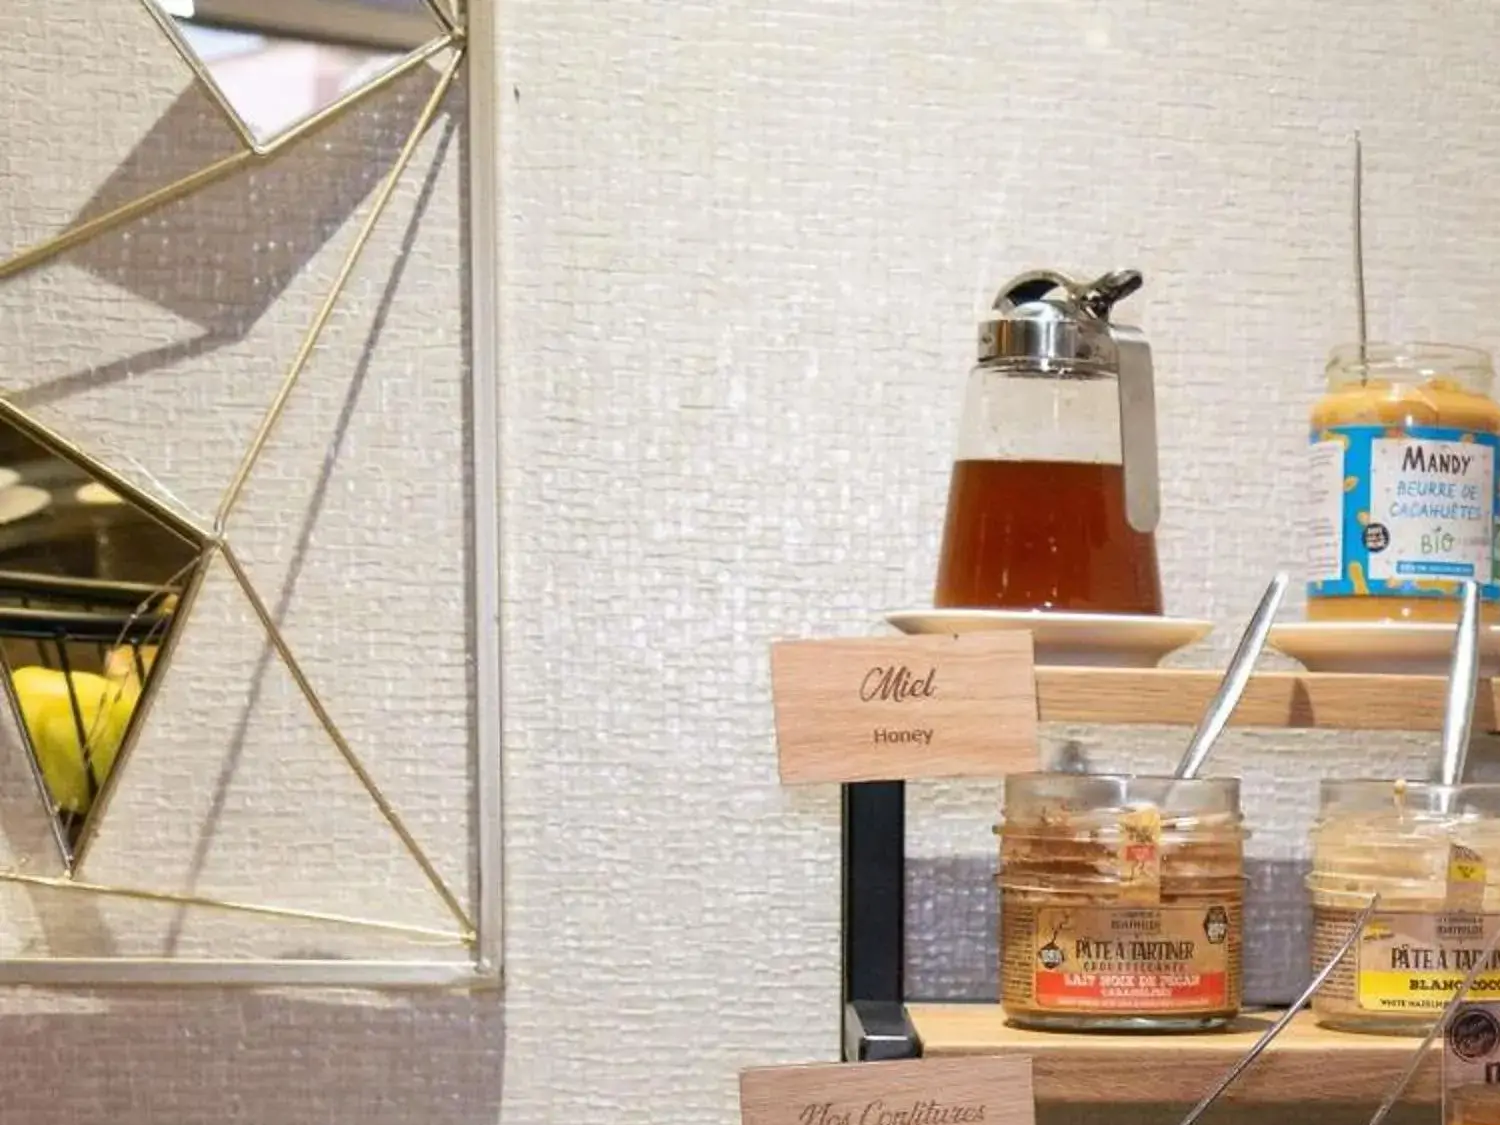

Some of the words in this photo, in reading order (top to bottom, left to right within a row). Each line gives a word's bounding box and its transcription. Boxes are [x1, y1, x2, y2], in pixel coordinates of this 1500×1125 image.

[1402, 446, 1471, 475] MANDY
[1396, 481, 1455, 499] BEURRE
[1461, 484, 1479, 500] DE
[859, 665, 938, 702] Miel
[873, 728, 934, 745] Honey
[1129, 940, 1195, 961] TARTINER
